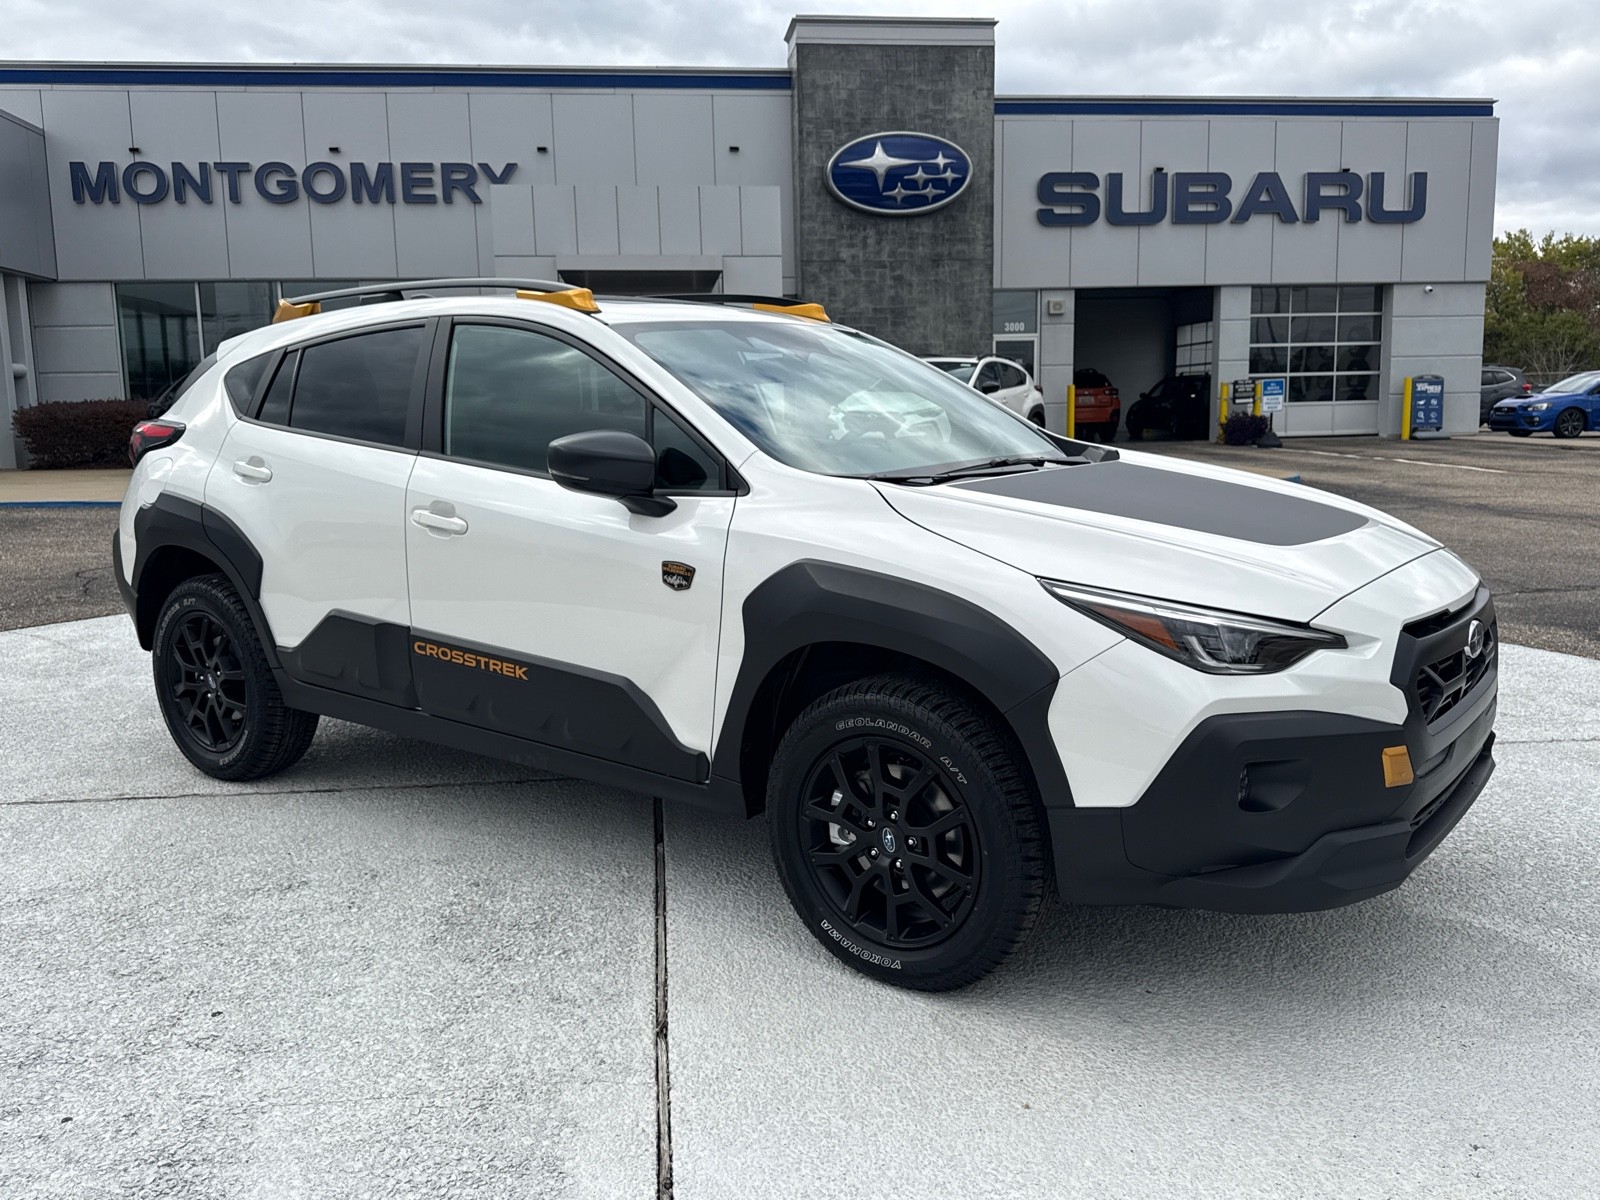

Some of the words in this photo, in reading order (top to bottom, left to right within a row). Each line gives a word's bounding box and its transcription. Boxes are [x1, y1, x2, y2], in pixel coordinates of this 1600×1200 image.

[69, 161, 518, 204] MONTGOMERY
[1037, 172, 1428, 227] SUBARU
[1004, 322, 1025, 332] 3000
[414, 641, 529, 681] CROSSTREK
[835, 717, 932, 749] GEOLANDAR
[939, 756, 968, 785] A/T
[820, 919, 901, 970] YOKOHAMA
